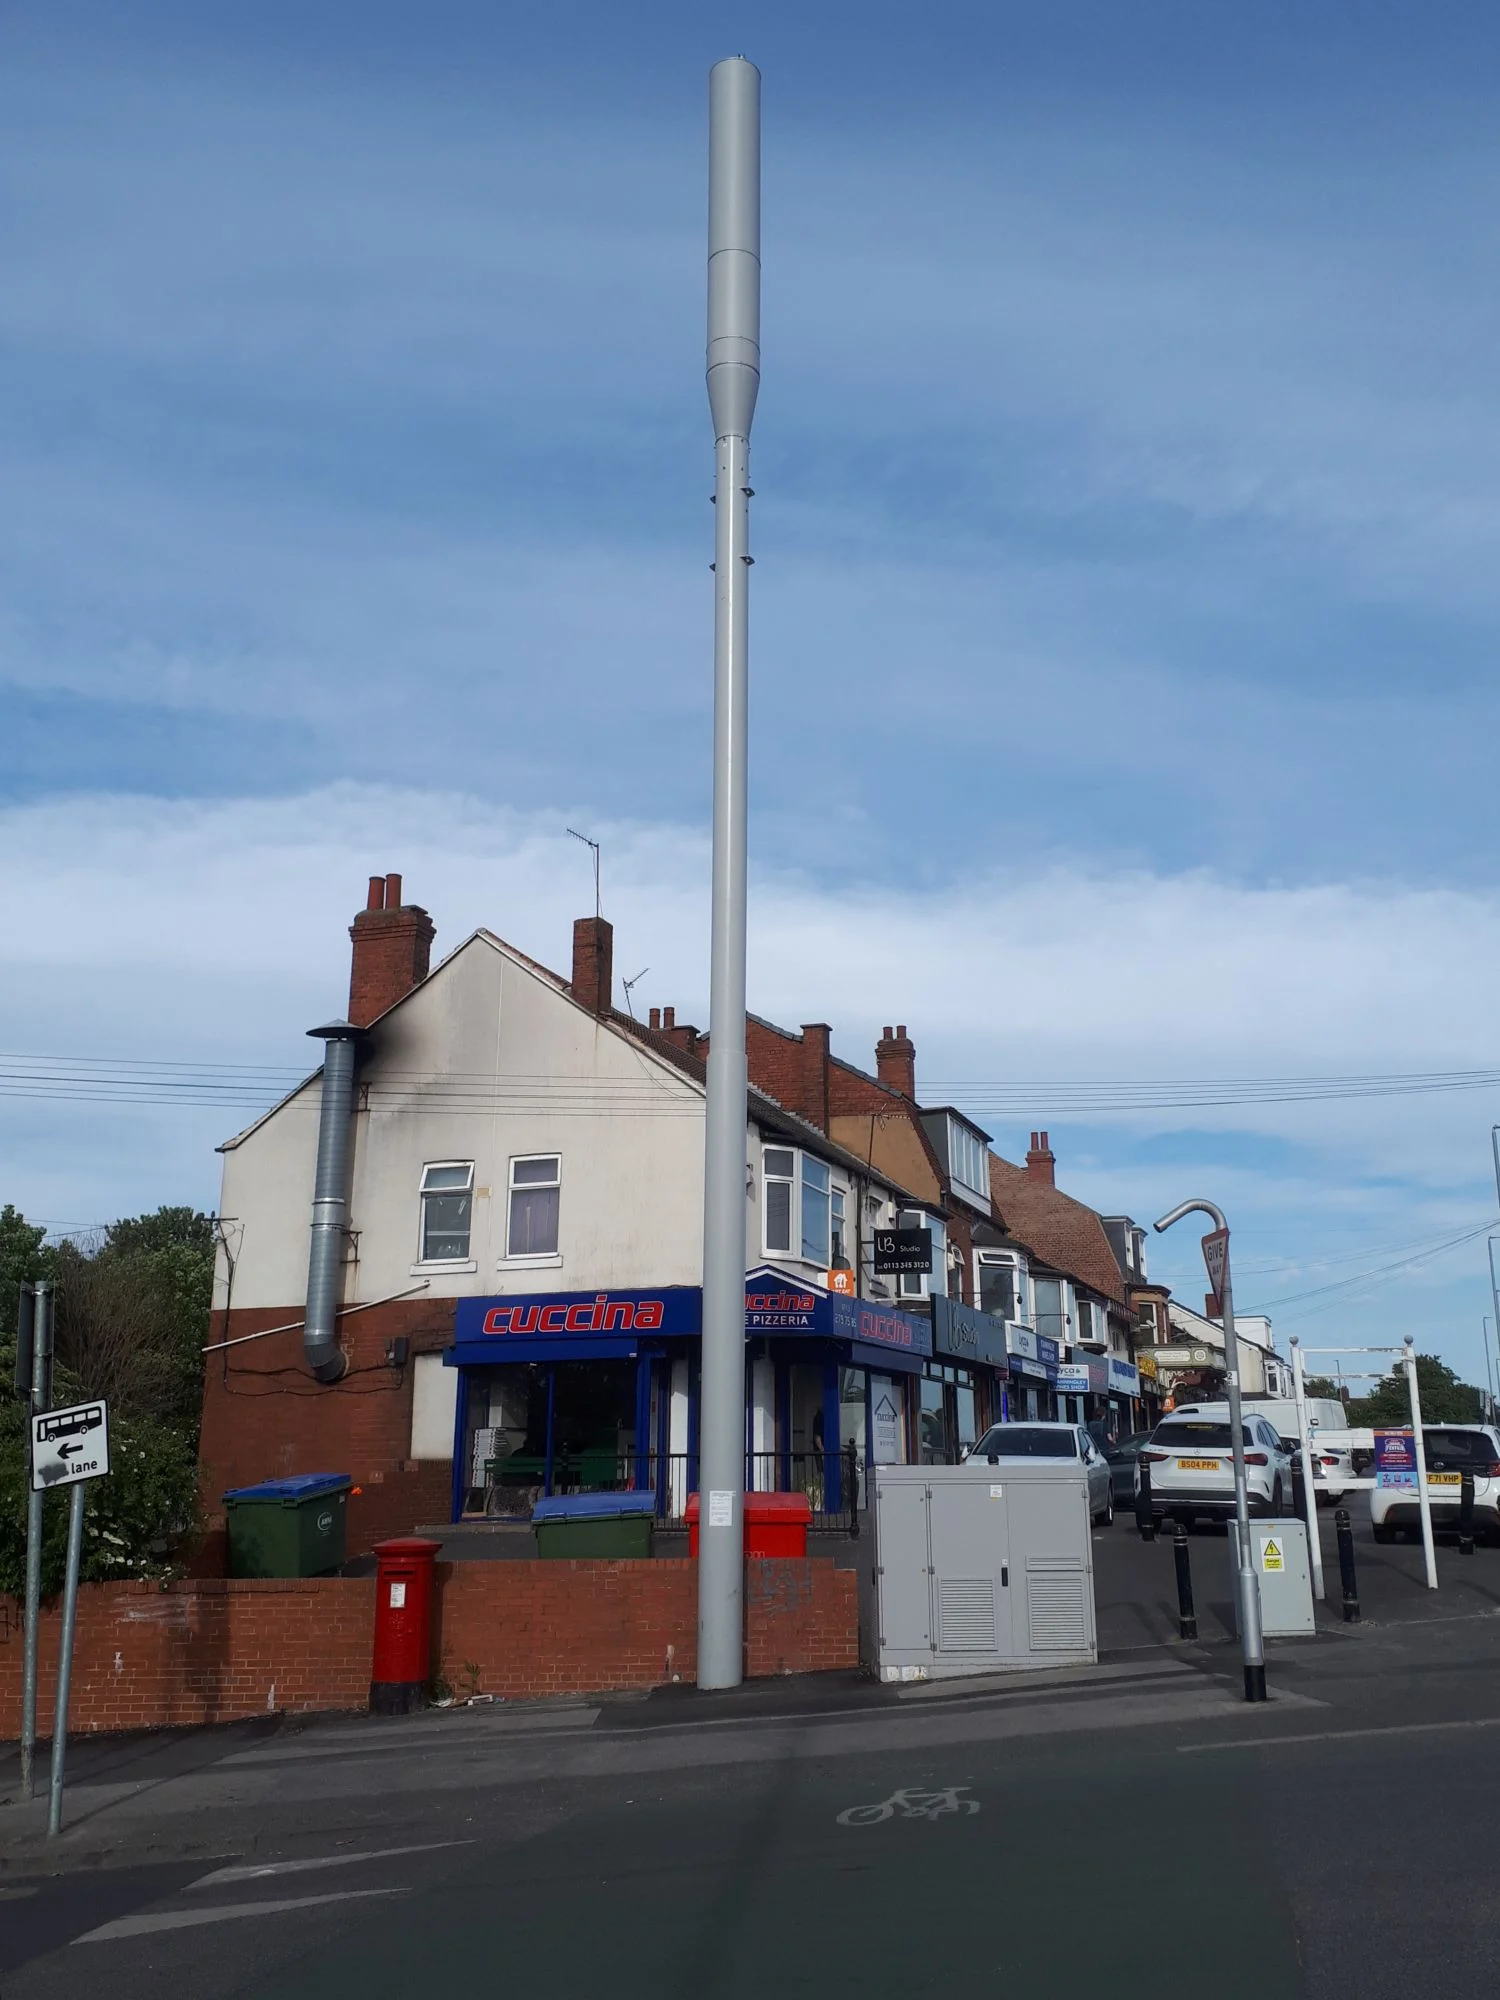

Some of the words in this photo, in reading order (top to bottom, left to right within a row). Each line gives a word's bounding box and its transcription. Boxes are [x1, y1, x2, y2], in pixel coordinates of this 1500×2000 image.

[1208, 1242, 1223, 1261] GIVE
[745, 1290, 815, 1311] ccina
[482, 1294, 665, 1334] cuccina
[753, 1315, 809, 1326] PIZZERIA
[859, 1311, 912, 1346] cuccina
[71, 1461, 98, 1474] lane
[1181, 1460, 1200, 1468] BS04
